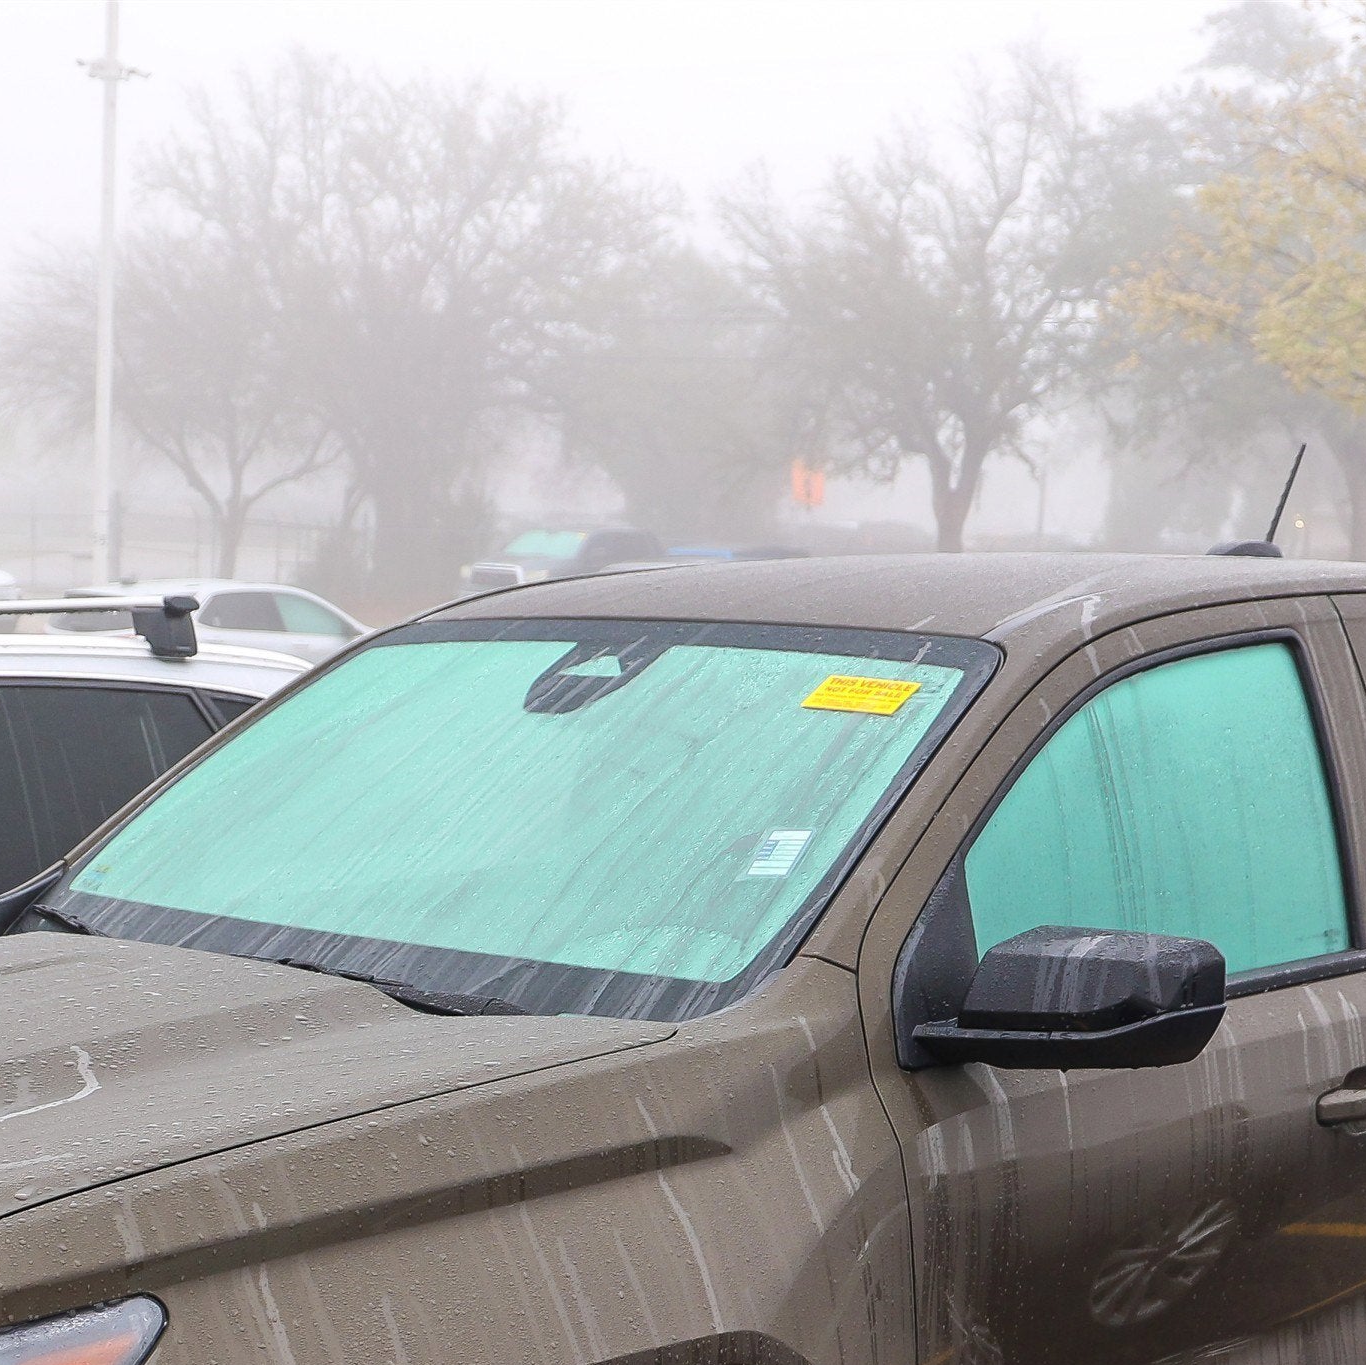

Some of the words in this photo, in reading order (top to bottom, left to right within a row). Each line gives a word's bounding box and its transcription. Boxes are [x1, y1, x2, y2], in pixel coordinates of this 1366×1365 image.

[830, 677, 859, 687] THIS
[860, 679, 915, 692] VEHICLE
[873, 690, 903, 698] SALE
